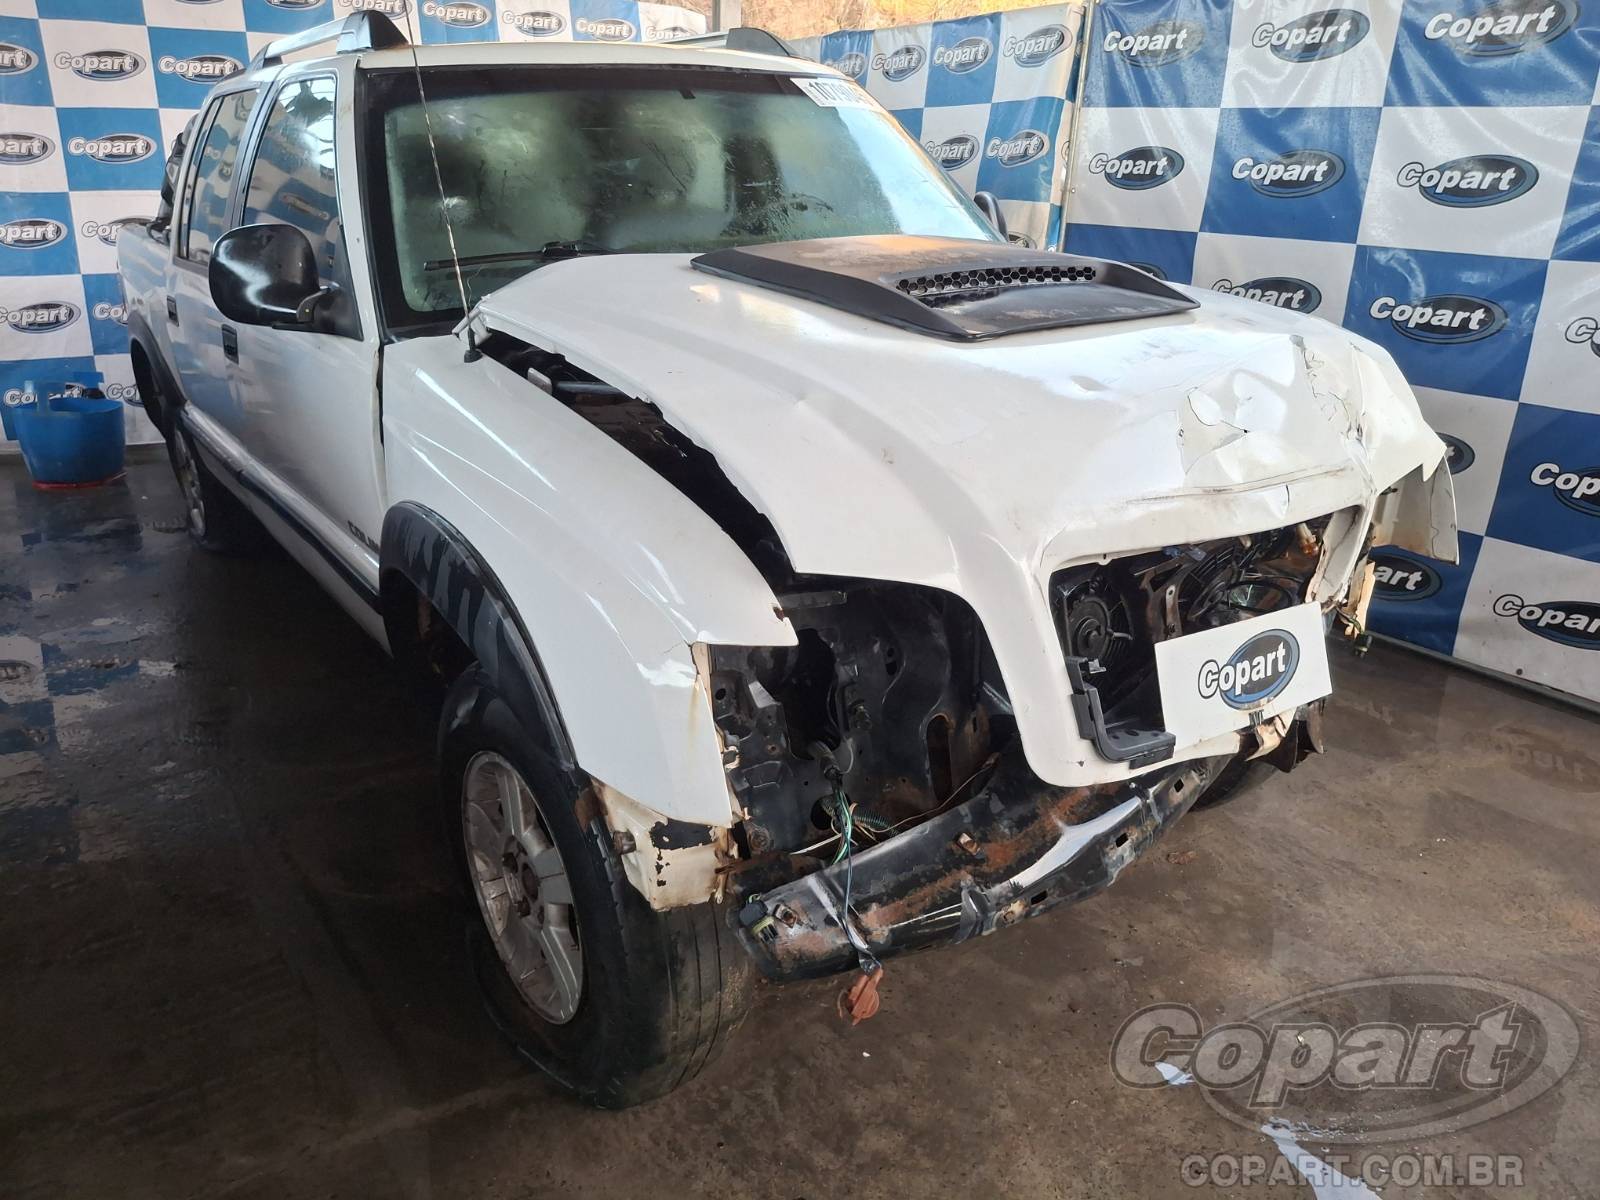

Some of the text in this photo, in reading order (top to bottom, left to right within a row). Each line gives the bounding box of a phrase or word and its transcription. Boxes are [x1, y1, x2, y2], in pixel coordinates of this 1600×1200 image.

[423, 3, 484, 21] Copart
[502, 11, 559, 31] Copart
[1424, 4, 1556, 43] Copart
[575, 18, 629, 37] Copart
[1252, 17, 1351, 50] Copart
[933, 42, 986, 68] Copart
[1003, 30, 1061, 61] Copart
[1103, 28, 1188, 56] Copart
[54, 52, 135, 73] Copart
[159, 56, 235, 78] Copart
[872, 50, 919, 74] Copart
[68, 136, 147, 158] Copart
[925, 140, 974, 162] Copart
[986, 134, 1040, 162] Copart
[1089, 153, 1169, 180] Copart
[1232, 157, 1329, 185] Copart
[1397, 162, 1517, 194] Copart
[1369, 296, 1488, 331] Copart
[1530, 462, 1600, 499] Cop
[1375, 565, 1423, 591] art
[1493, 594, 1600, 633] Copar
[1198, 642, 1287, 698] Copart
